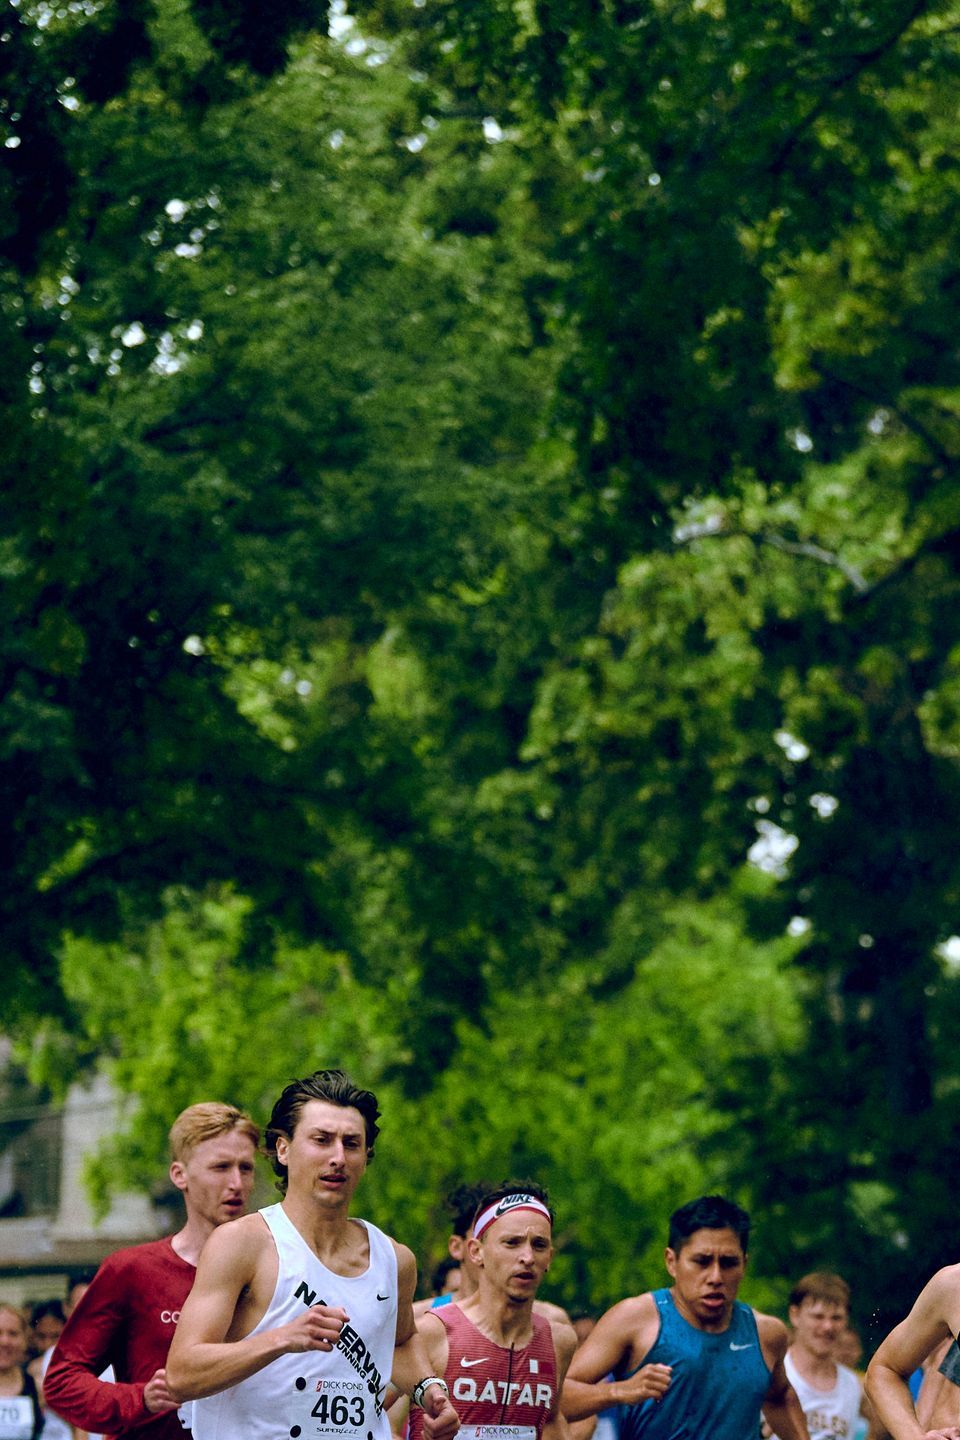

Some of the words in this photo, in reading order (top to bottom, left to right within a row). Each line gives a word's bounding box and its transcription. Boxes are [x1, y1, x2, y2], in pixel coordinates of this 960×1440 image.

[501, 1194, 533, 1206] NIKE
[335, 1340, 367, 1380] UNNING
[323, 1381, 341, 1390] DICK
[342, 1382, 364, 1391] POND
[453, 1377, 552, 1409] QATAR
[311, 1394, 365, 1427] 463
[481, 1426, 498, 1435] DICK
[499, 1427, 520, 1435] POND
